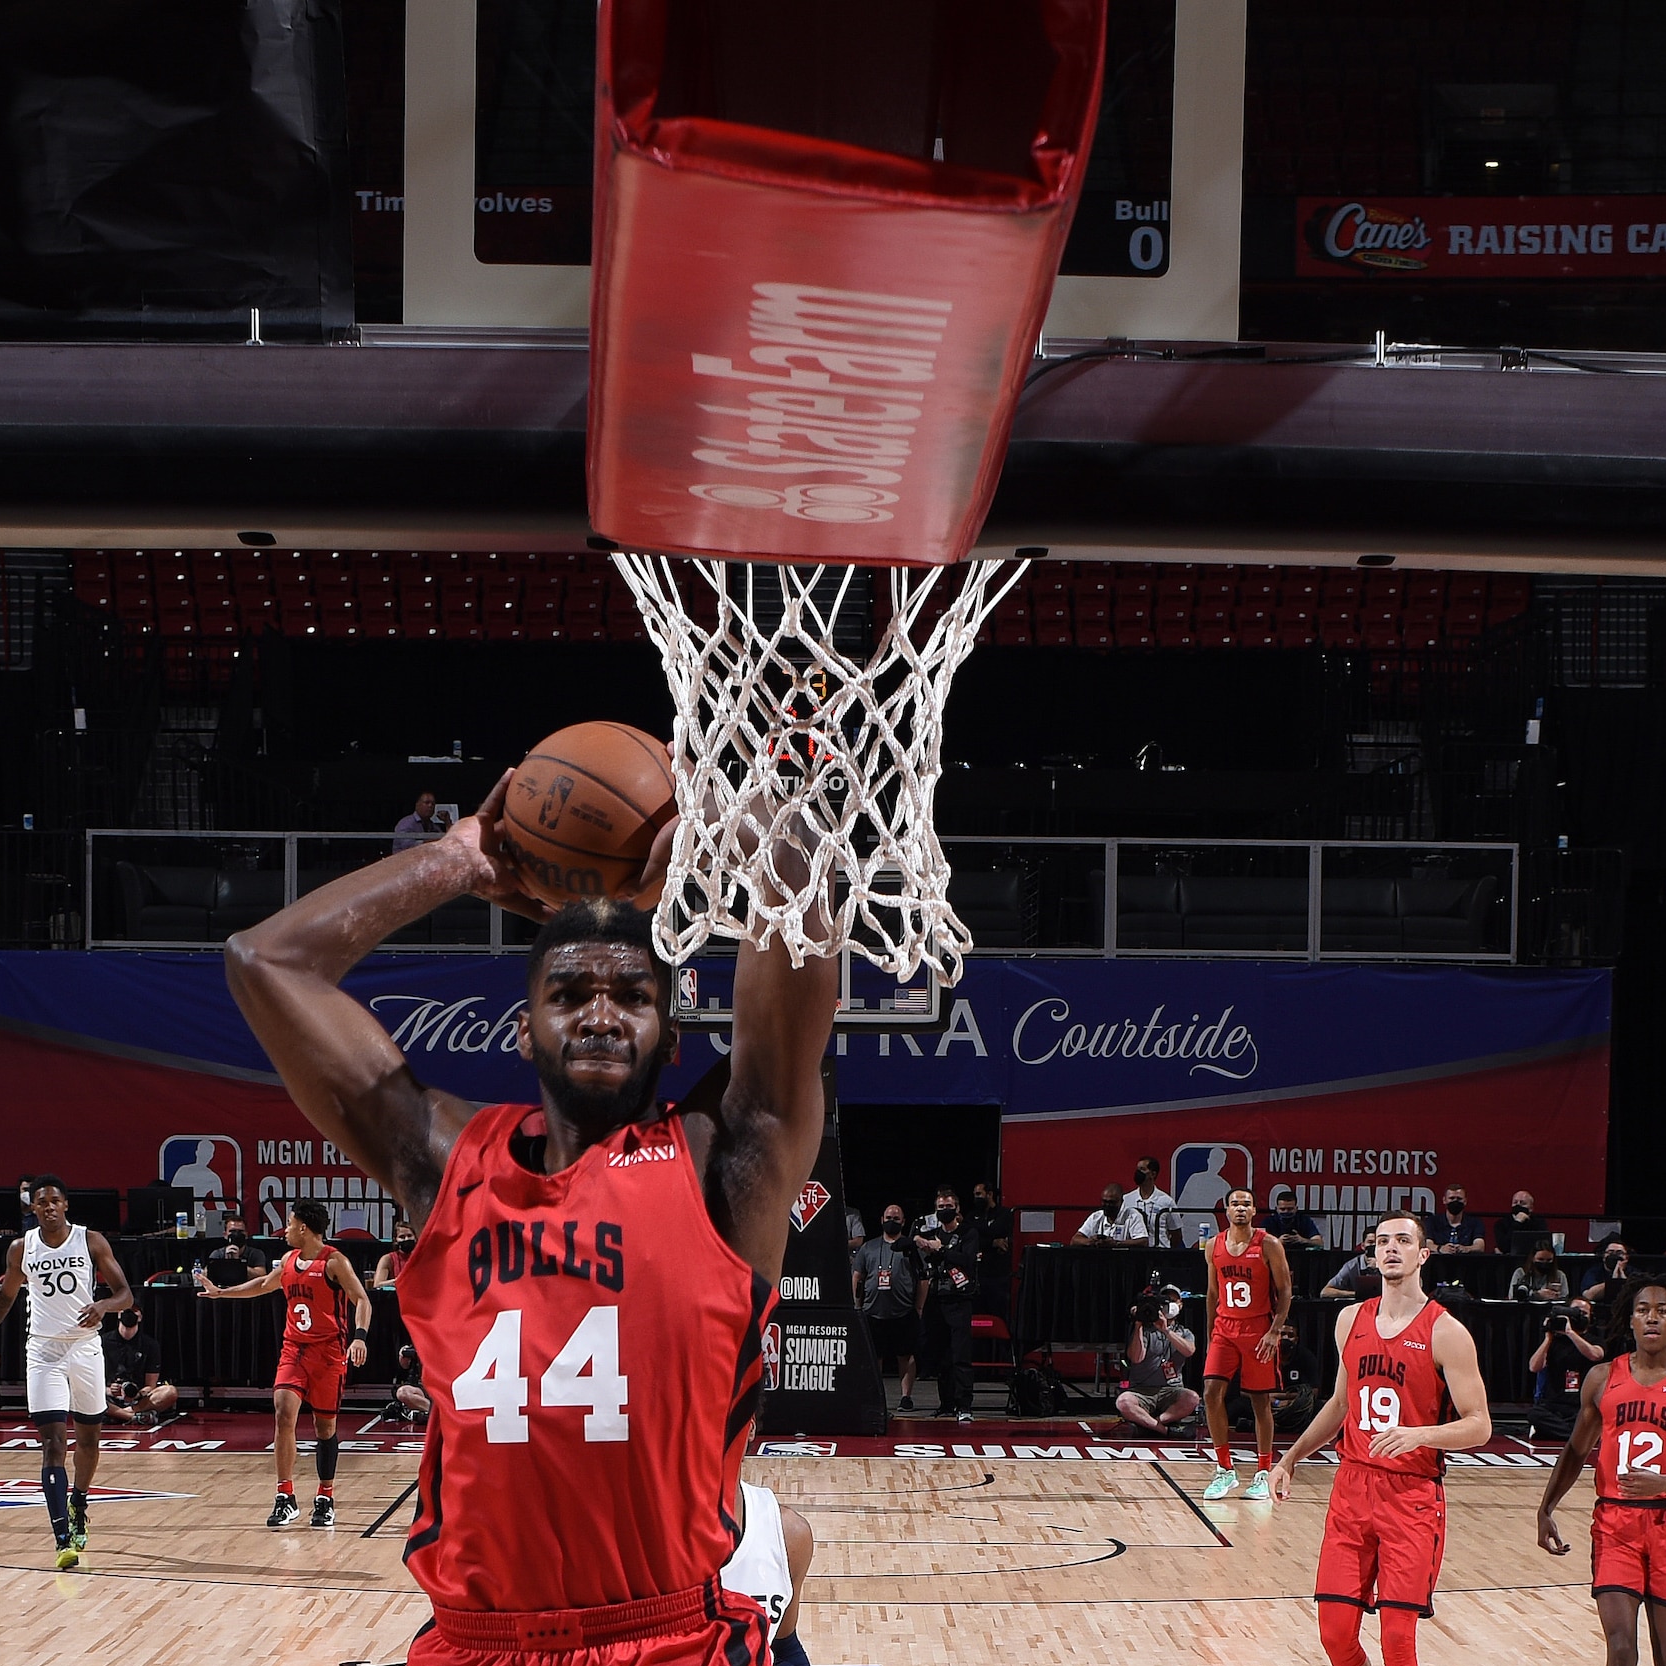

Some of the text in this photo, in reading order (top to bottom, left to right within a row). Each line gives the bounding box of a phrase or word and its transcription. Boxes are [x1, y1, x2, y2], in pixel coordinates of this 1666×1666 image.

[1114, 199, 1168, 222] Bull
[1325, 202, 1433, 258] Cane's
[1448, 223, 1613, 255] RAISING
[1129, 226, 1164, 271] 0
[1013, 997, 1260, 1080] Courtside
[257, 1139, 313, 1165] MGM
[1269, 1148, 1438, 1176] MGM RESORTS
[27, 1255, 86, 1274] WOLVES
[469, 1220, 625, 1306] BULLS
[42, 1270, 78, 1298] 30
[780, 1276, 821, 1301] @NBA
[1225, 1281, 1252, 1308] 13
[293, 1303, 313, 1333] 3
[785, 1325, 848, 1337] MGM RESORTS
[784, 1338, 848, 1367] SUMMER
[451, 1305, 630, 1444] 44
[784, 1364, 837, 1392] LEAGUE
[1358, 1354, 1406, 1387] BULLS
[1358, 1385, 1401, 1433] 19
[1616, 1430, 1664, 1475] 12
